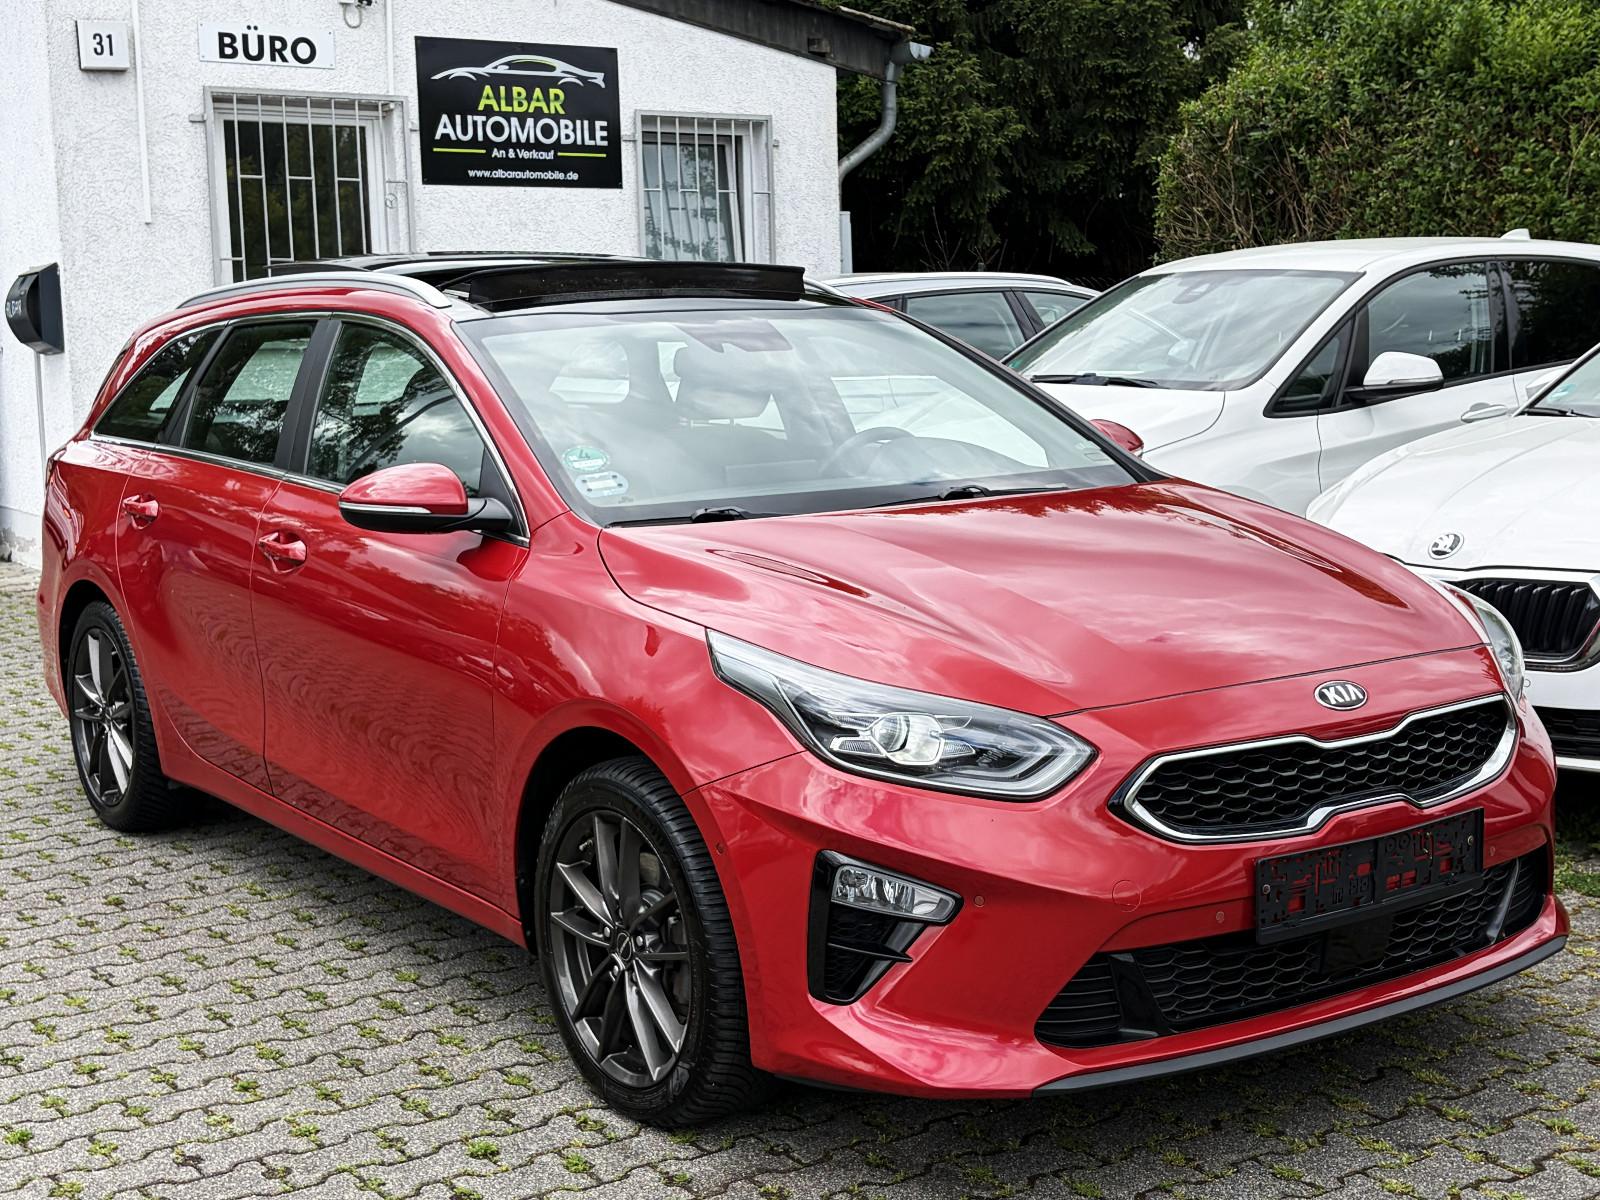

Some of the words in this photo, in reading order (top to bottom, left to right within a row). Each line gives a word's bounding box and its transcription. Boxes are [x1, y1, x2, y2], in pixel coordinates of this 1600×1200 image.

[92, 32, 114, 56] 31
[218, 24, 317, 64] BÜRO
[477, 84, 566, 115] ALBAR
[434, 113, 609, 146] AUTOMOBILE
[491, 148, 506, 159] An
[507, 149, 516, 159] &
[516, 149, 555, 160] Verkauf
[467, 168, 579, 181] www.albarautomobile.de
[1322, 684, 1364, 704] KIA
